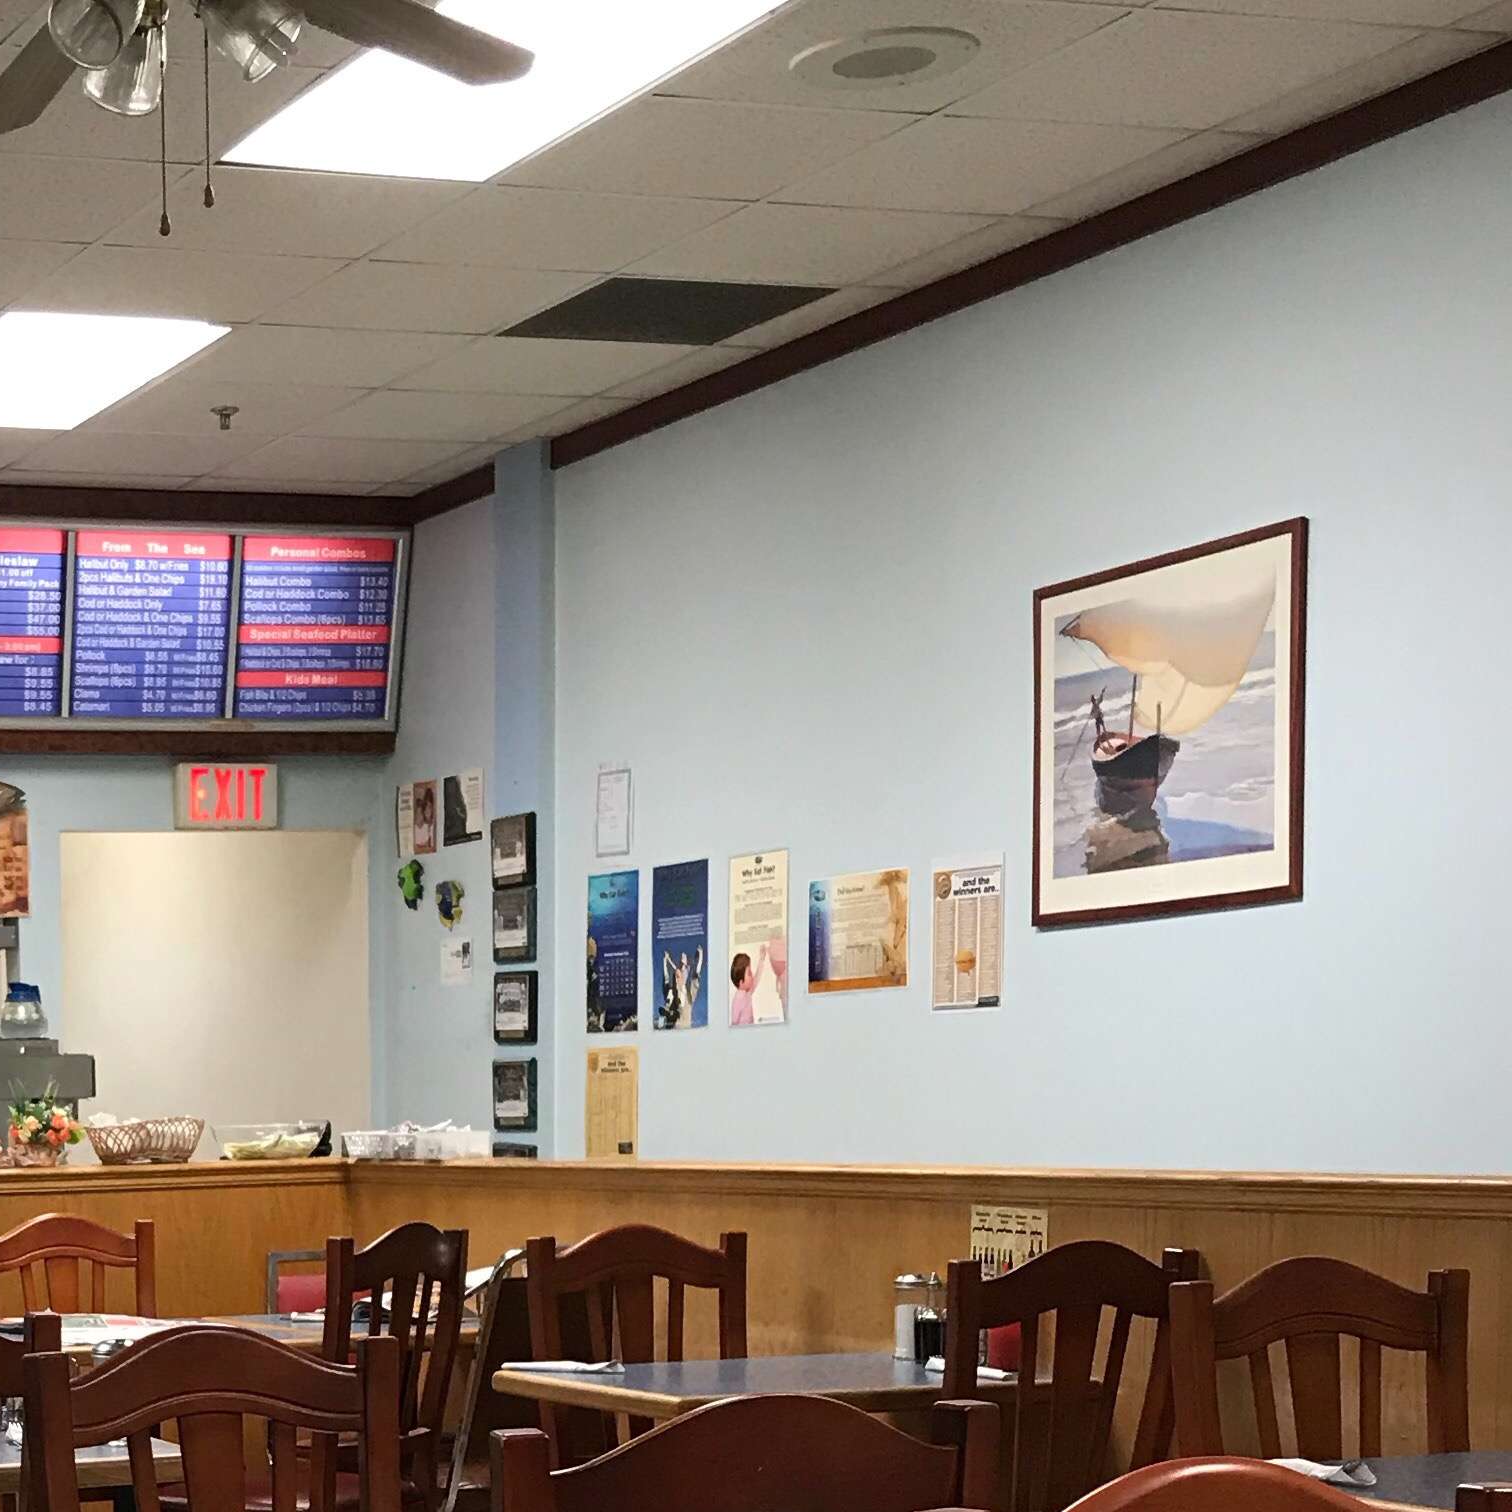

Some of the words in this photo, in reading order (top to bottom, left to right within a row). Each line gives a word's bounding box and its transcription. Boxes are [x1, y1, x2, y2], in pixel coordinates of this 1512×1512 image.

[101, 541, 132, 553] From
[145, 543, 169, 554] The
[183, 544, 206, 555] Sea
[270, 546, 320, 558] Personal
[321, 548, 367, 559] Combos
[78, 559, 109, 570] Halibut
[109, 560, 130, 572] Only
[9, 580, 38, 590] Family
[142, 574, 161, 585] One
[161, 574, 185, 586] Chips
[245, 577, 278, 587] Halibut
[279, 577, 312, 587] Combo
[244, 589, 264, 599] Cod
[276, 590, 316, 600] Haddock
[317, 590, 350, 600] Combo
[77, 597, 95, 608] Cod
[106, 598, 142, 609] Haddock
[143, 598, 164, 611] Only
[244, 601, 278, 612] Pollock
[279, 602, 312, 612] Combo
[77, 611, 94, 621] Cod
[105, 611, 141, 622] Haddock
[151, 612, 169, 623] One
[169, 612, 193, 624] Chips
[243, 614, 283, 625] Scallops
[283, 614, 317, 625] Combo
[249, 629, 292, 641] Special
[293, 630, 339, 640] Seafood
[339, 630, 377, 640] Platter
[75, 650, 106, 661] Pollock
[74, 676, 109, 687] Scallops
[285, 674, 310, 685] Kids
[311, 674, 338, 685] Meal
[190, 767, 268, 821] EXIT
[962, 877, 977, 888] and
[978, 876, 991, 886] the
[953, 886, 981, 897] winners
